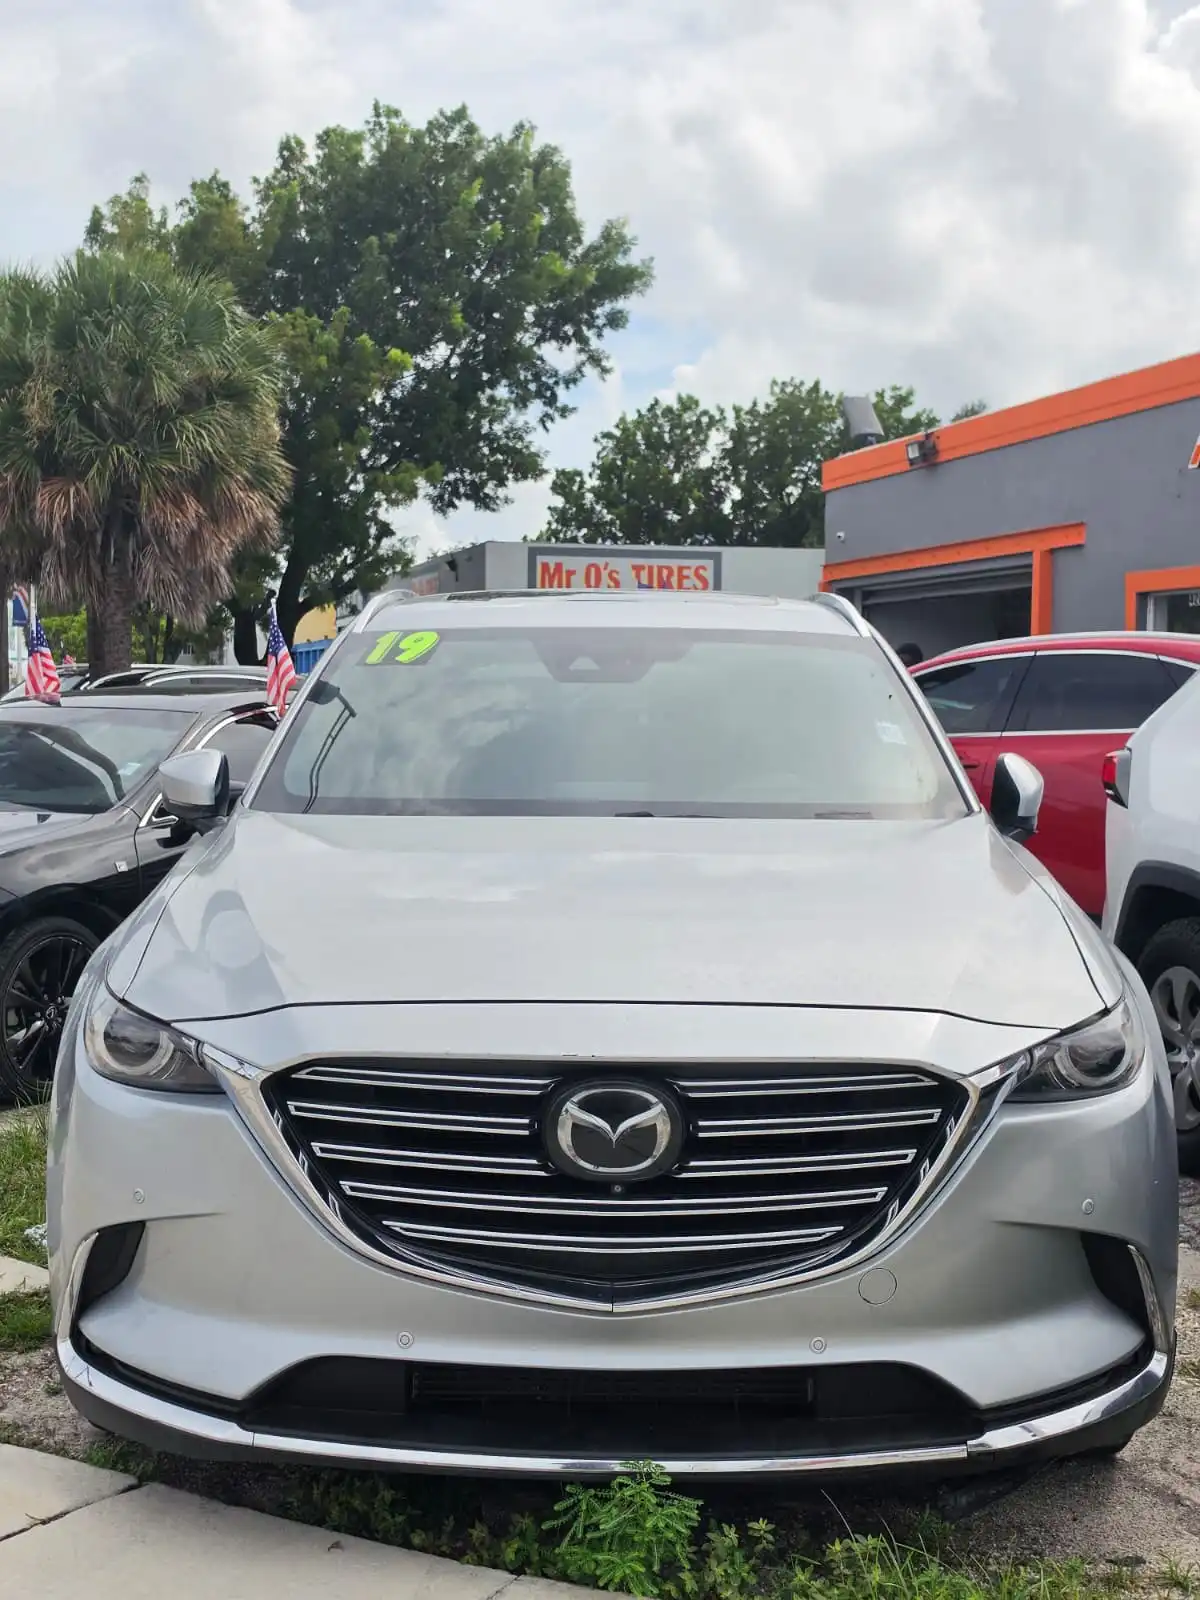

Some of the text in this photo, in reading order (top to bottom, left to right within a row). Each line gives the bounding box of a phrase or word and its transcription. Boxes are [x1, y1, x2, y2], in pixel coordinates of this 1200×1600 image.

[540, 561, 710, 591] Mr O's TIRES
[366, 631, 439, 664] 19
